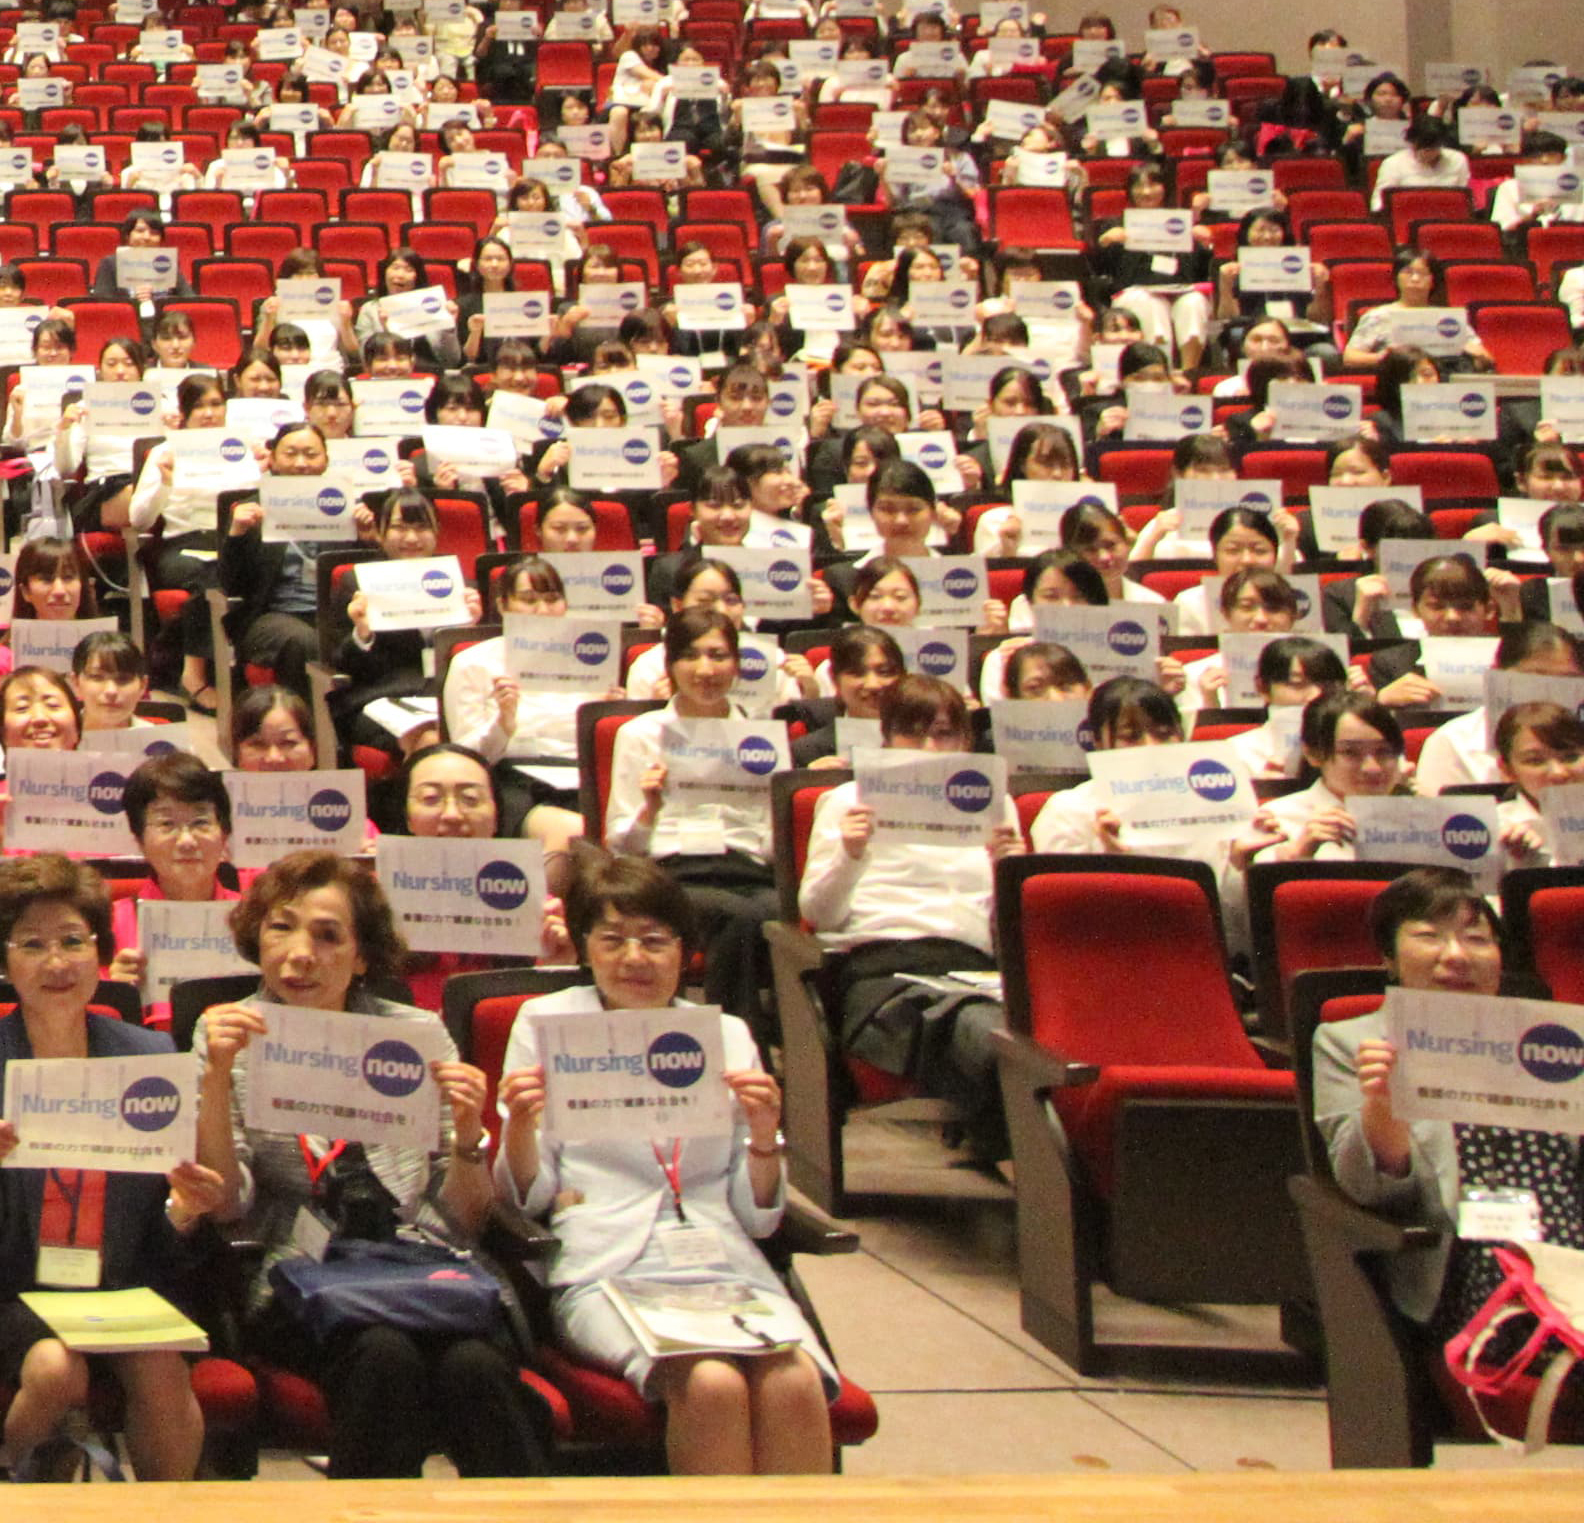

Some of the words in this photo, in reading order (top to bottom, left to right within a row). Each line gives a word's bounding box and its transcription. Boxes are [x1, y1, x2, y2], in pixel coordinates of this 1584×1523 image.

[1325, 400, 1350, 412] now
[1460, 400, 1487, 411] now
[623, 445, 650, 458] now
[318, 496, 346, 509] now
[423, 577, 452, 590] now
[602, 573, 631, 586] now
[769, 571, 799, 583] now
[945, 578, 975, 590] now
[1044, 627, 1107, 645] Nursing
[1109, 632, 1147, 645] now
[514, 638, 573, 656] Nursing
[576, 641, 609, 656] now
[920, 653, 955, 666] now
[1005, 727, 1075, 744] Nursing
[669, 745, 738, 767] Nursing
[741, 749, 775, 763] now
[19, 780, 86, 802] Nursing
[870, 780, 945, 802] Nursing
[948, 783, 990, 798] now
[1111, 776, 1188, 795] Nursing
[1191, 774, 1235, 789] now
[237, 801, 307, 820] Nursing
[311, 803, 349, 819] now
[1364, 827, 1441, 844] Nursing
[1445, 830, 1489, 844] now
[393, 872, 473, 896] Nursing
[479, 874, 526, 894] now
[152, 933, 232, 953] Nursing
[1406, 1029, 1515, 1063] Nursing
[1522, 1044, 1584, 1064] now
[264, 1040, 359, 1077] Nursing
[367, 1058, 423, 1078] now
[554, 1053, 644, 1075] Nursing
[650, 1050, 703, 1070] now
[21, 1092, 118, 1118] Nursing
[124, 1095, 178, 1114] now
